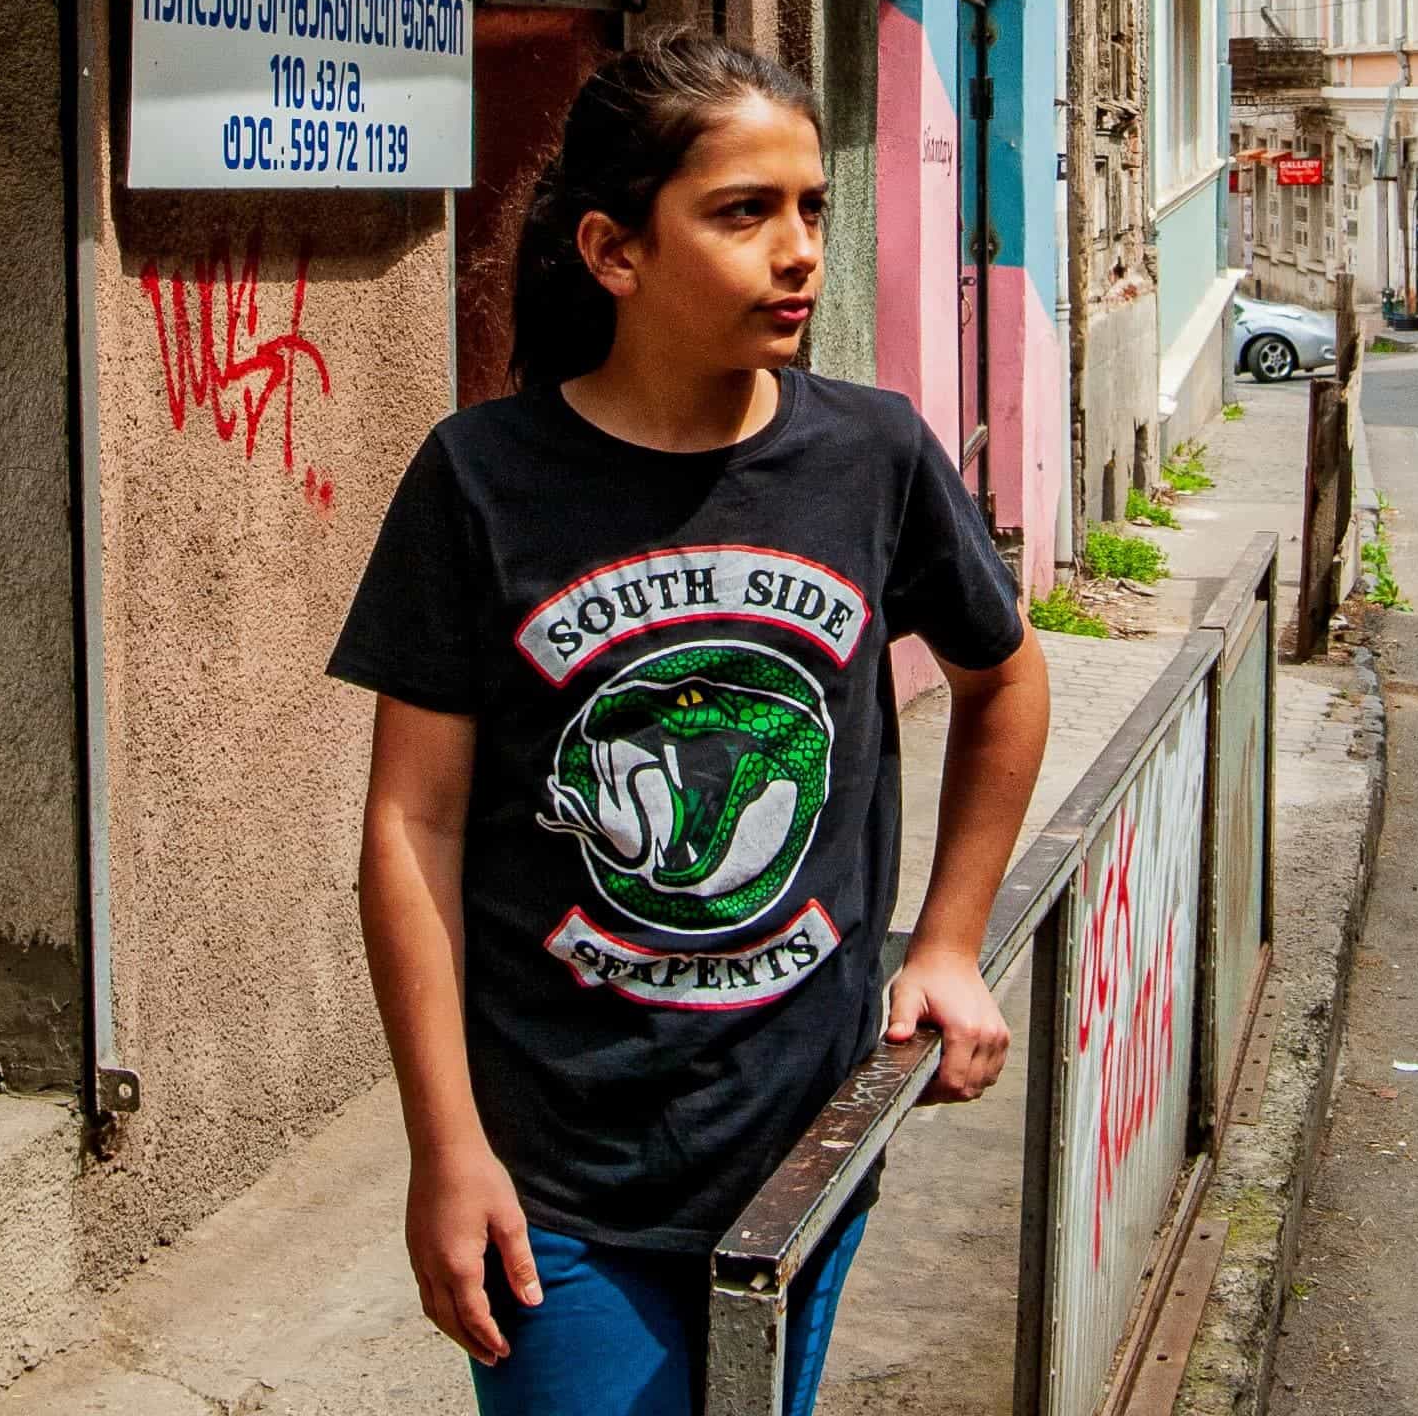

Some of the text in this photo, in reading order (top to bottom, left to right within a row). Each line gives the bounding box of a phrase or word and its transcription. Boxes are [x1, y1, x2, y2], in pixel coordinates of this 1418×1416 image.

[270, 53, 305, 110] 110
[290, 118, 329, 172] 599
[335, 120, 358, 172] 72
[1279, 159, 1321, 170] GALLERY
[546, 566, 855, 661] SOUTH SIDE
[569, 927, 820, 990] SERPENTS
